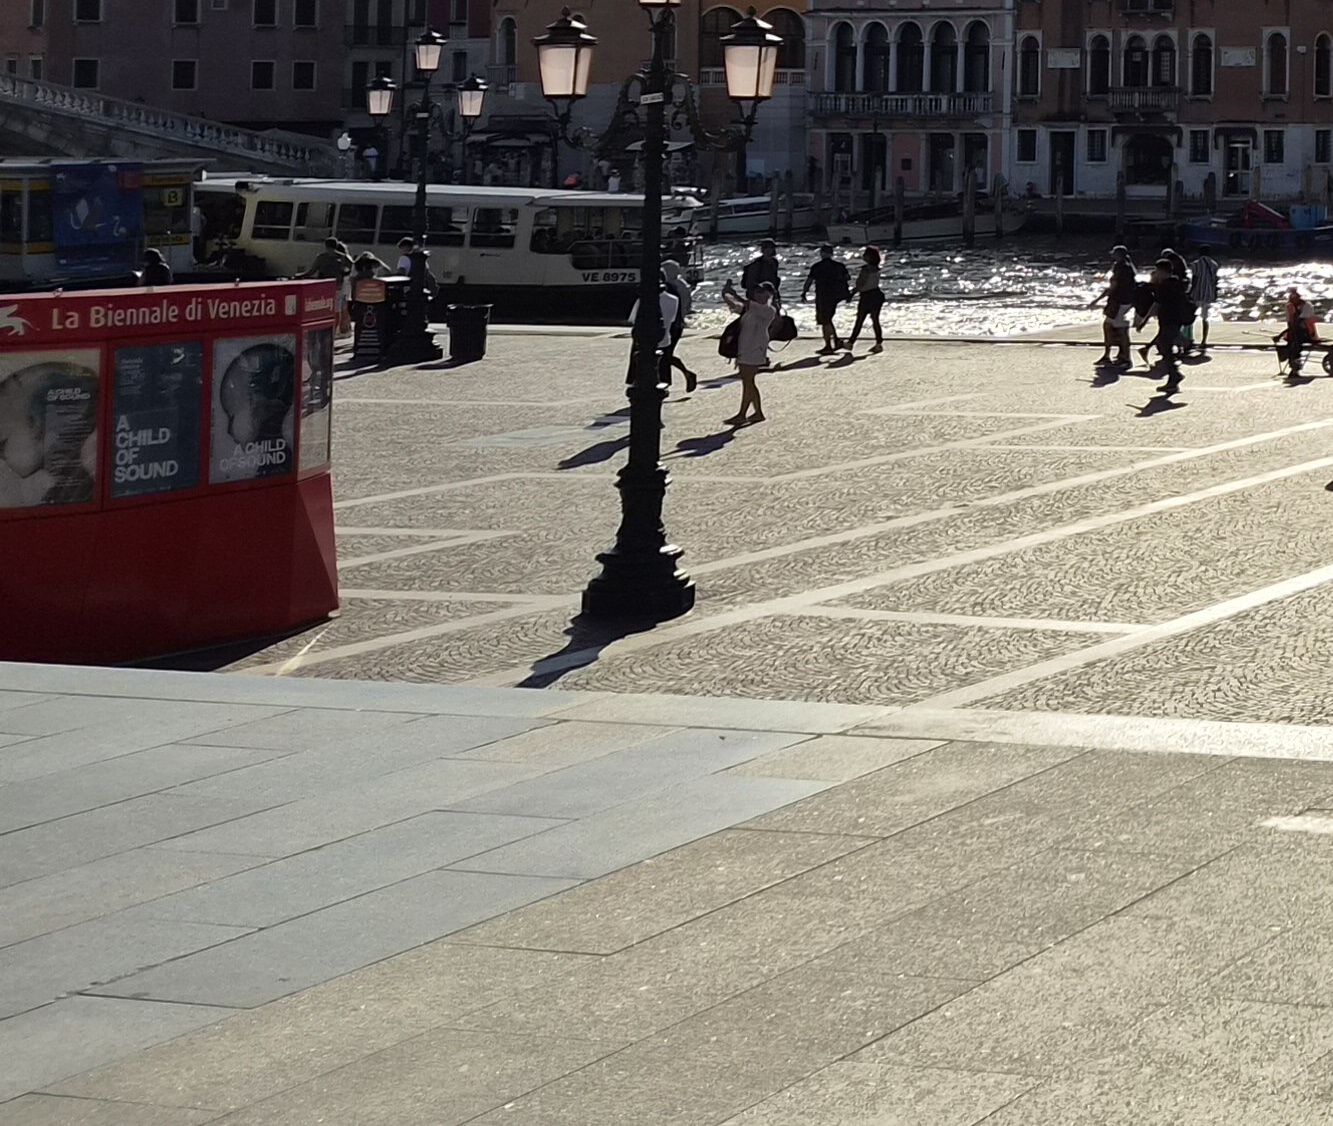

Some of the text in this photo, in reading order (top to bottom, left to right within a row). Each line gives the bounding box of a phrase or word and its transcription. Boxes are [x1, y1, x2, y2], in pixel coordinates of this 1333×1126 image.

[582, 272, 636, 282] VE 8975
[51, 293, 276, 330] La Biennale di Venezia
[59, 392, 91, 401] SOUND
[116, 414, 130, 432] A
[115, 427, 171, 448] CHILD
[233, 438, 286, 456] A CHILD
[115, 447, 140, 466] OF
[219, 451, 286, 472] OF SOUND
[114, 460, 179, 483] SOUND
